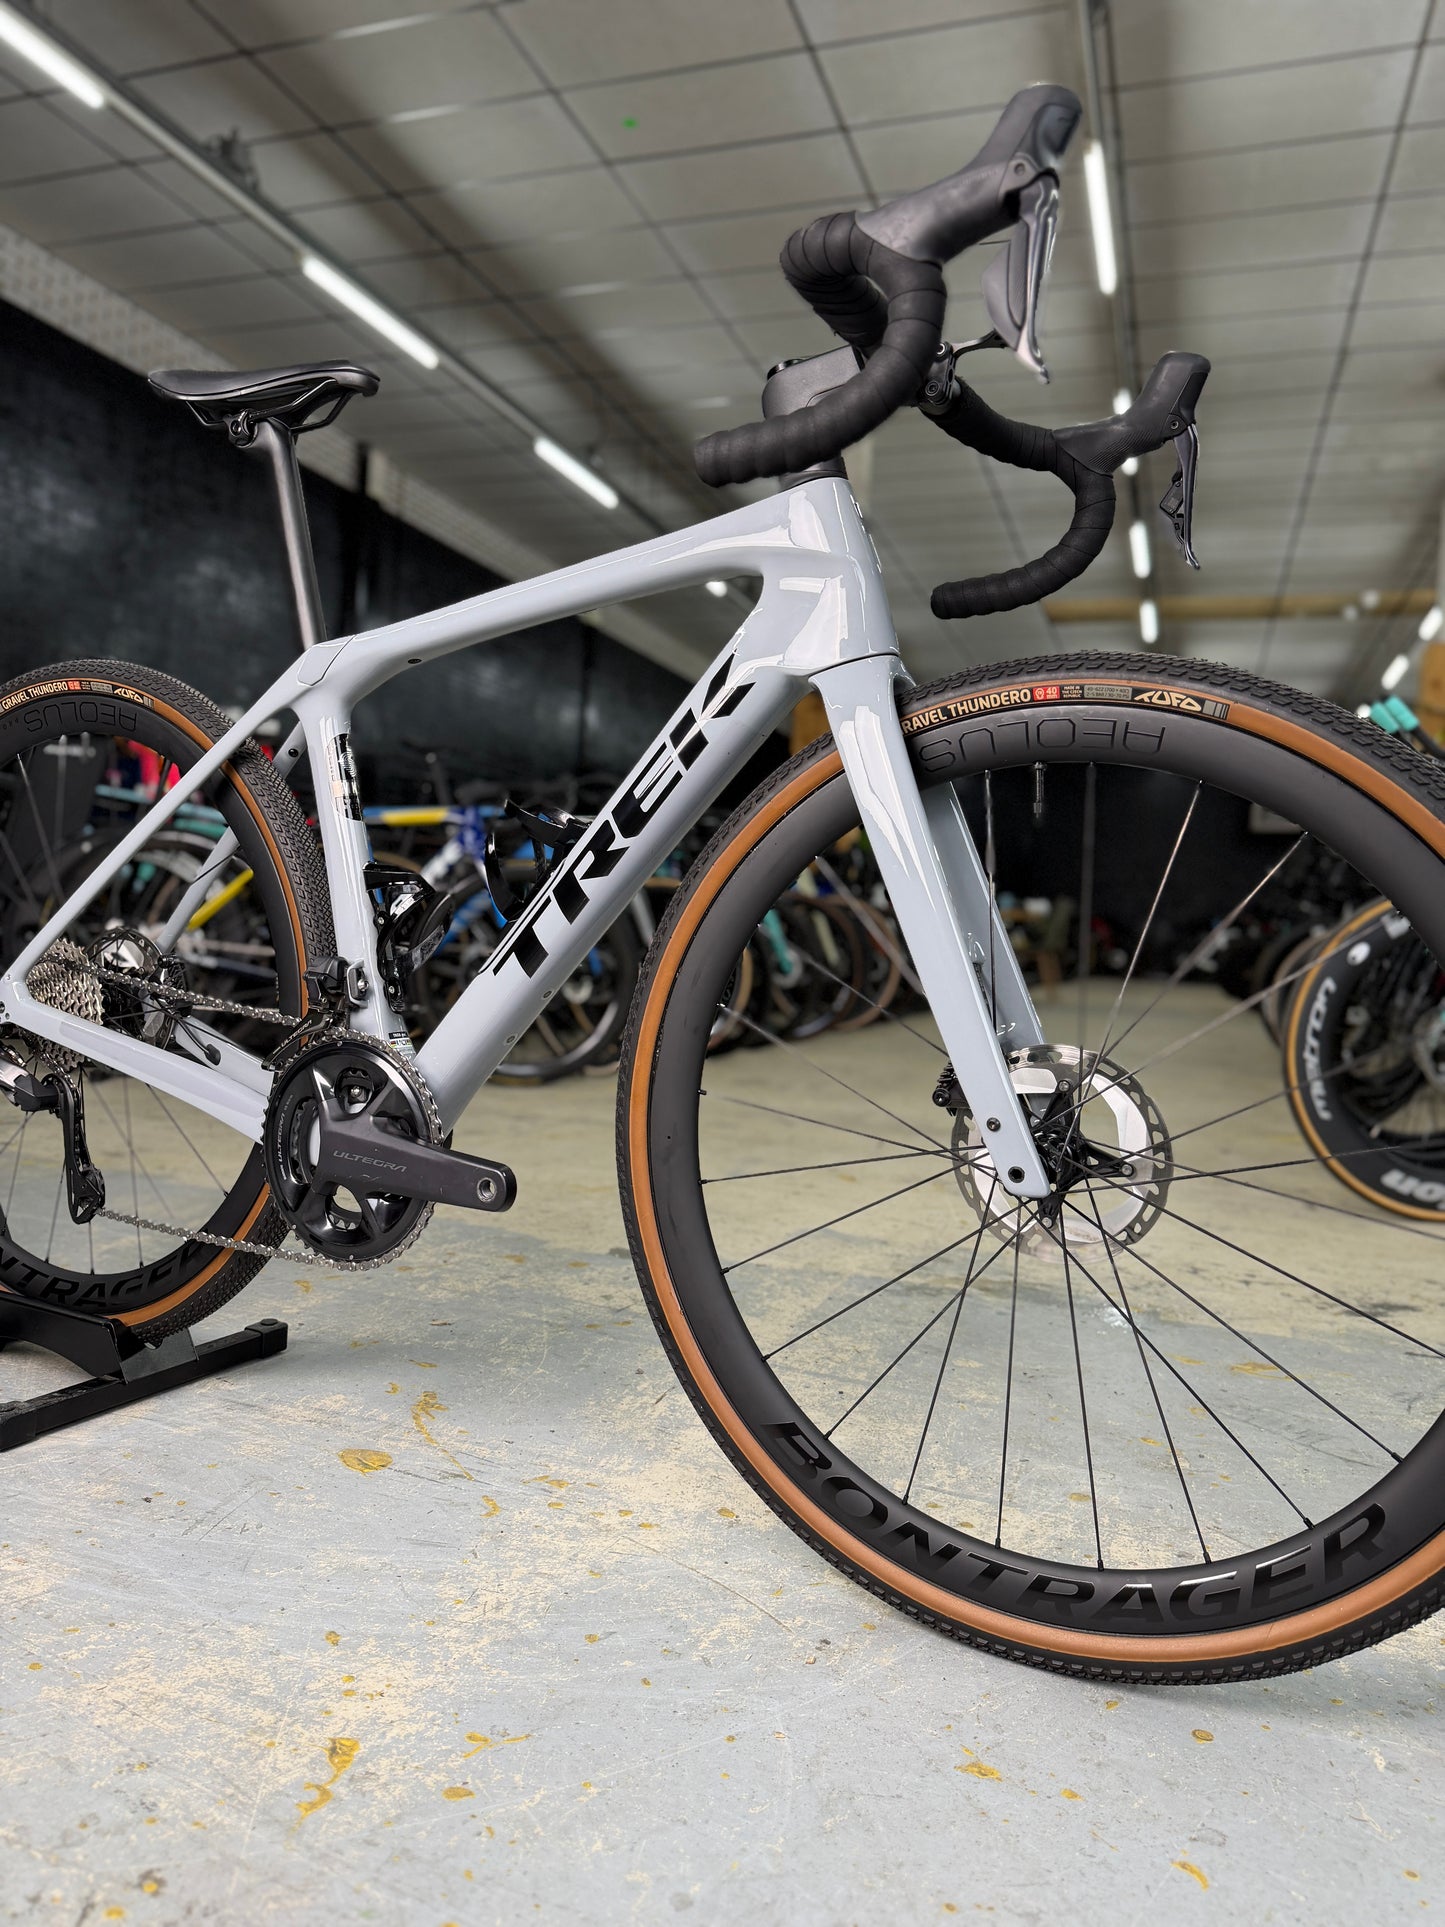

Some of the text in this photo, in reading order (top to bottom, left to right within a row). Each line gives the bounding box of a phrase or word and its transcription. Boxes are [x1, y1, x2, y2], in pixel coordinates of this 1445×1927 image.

[2, 691, 30, 710] GRAVEL
[29, 681, 69, 698] THUNDERO
[947, 688, 1031, 718] THUNDERO
[1046, 686, 1057, 695] 40
[24, 701, 138, 732] AEOLUS
[919, 716, 1165, 773] AEOLUS
[493, 648, 757, 979] TREK
[332, 1150, 408, 1173] ULTEGRA
[760, 1421, 1386, 1623] BONTRAGER
